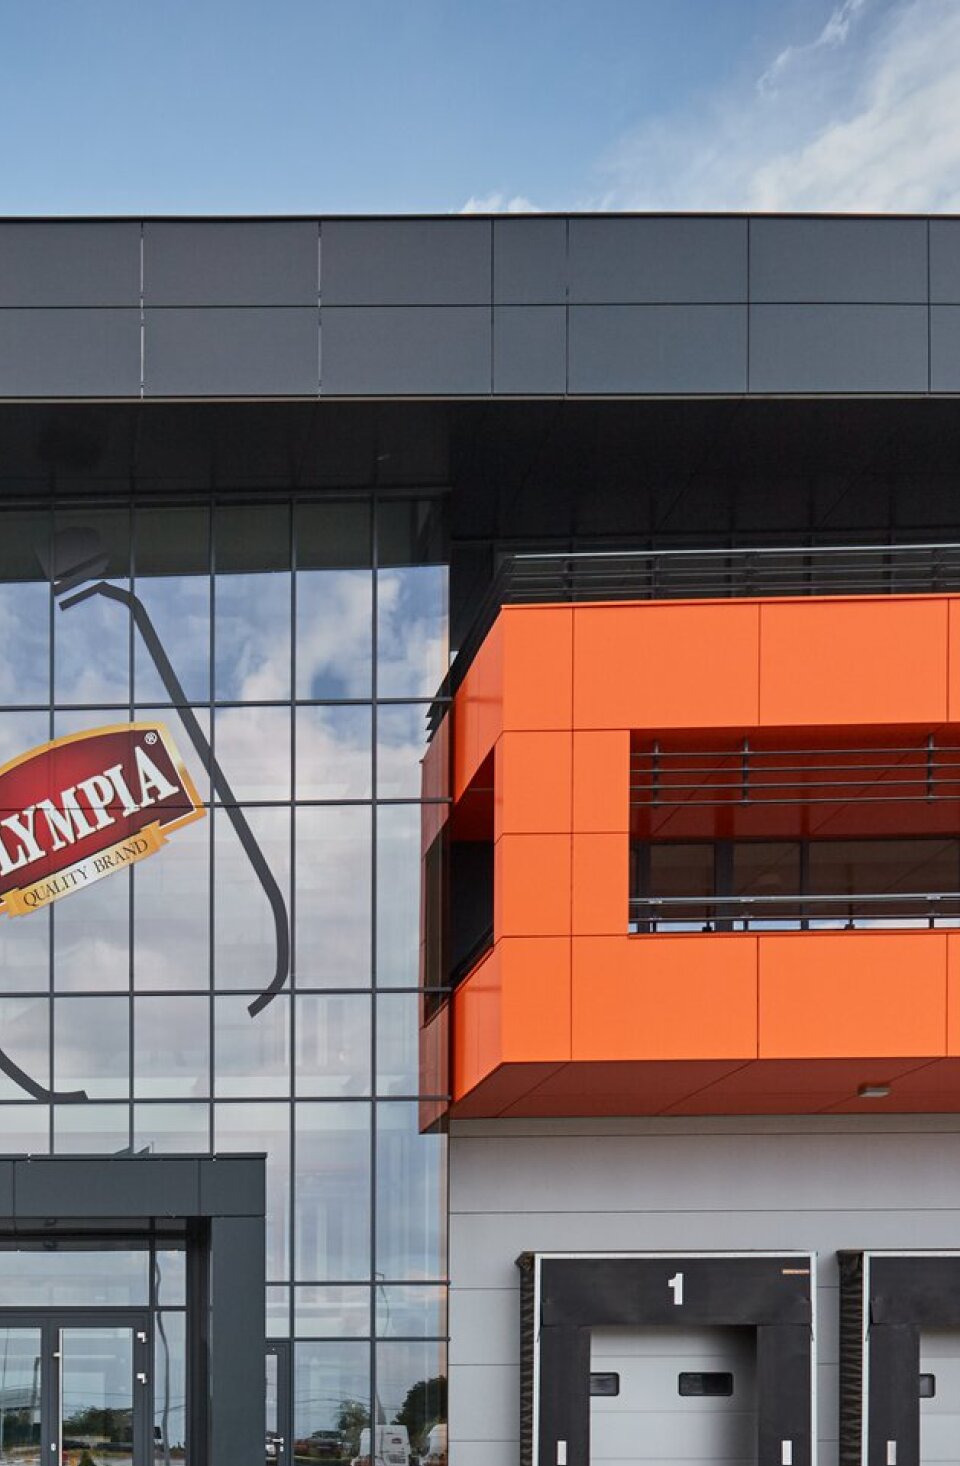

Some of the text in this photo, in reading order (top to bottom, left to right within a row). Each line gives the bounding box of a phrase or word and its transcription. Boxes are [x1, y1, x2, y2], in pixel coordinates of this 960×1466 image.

[23, 839, 148, 907] QUALITY BRAND
[668, 1272, 683, 1305] 1
